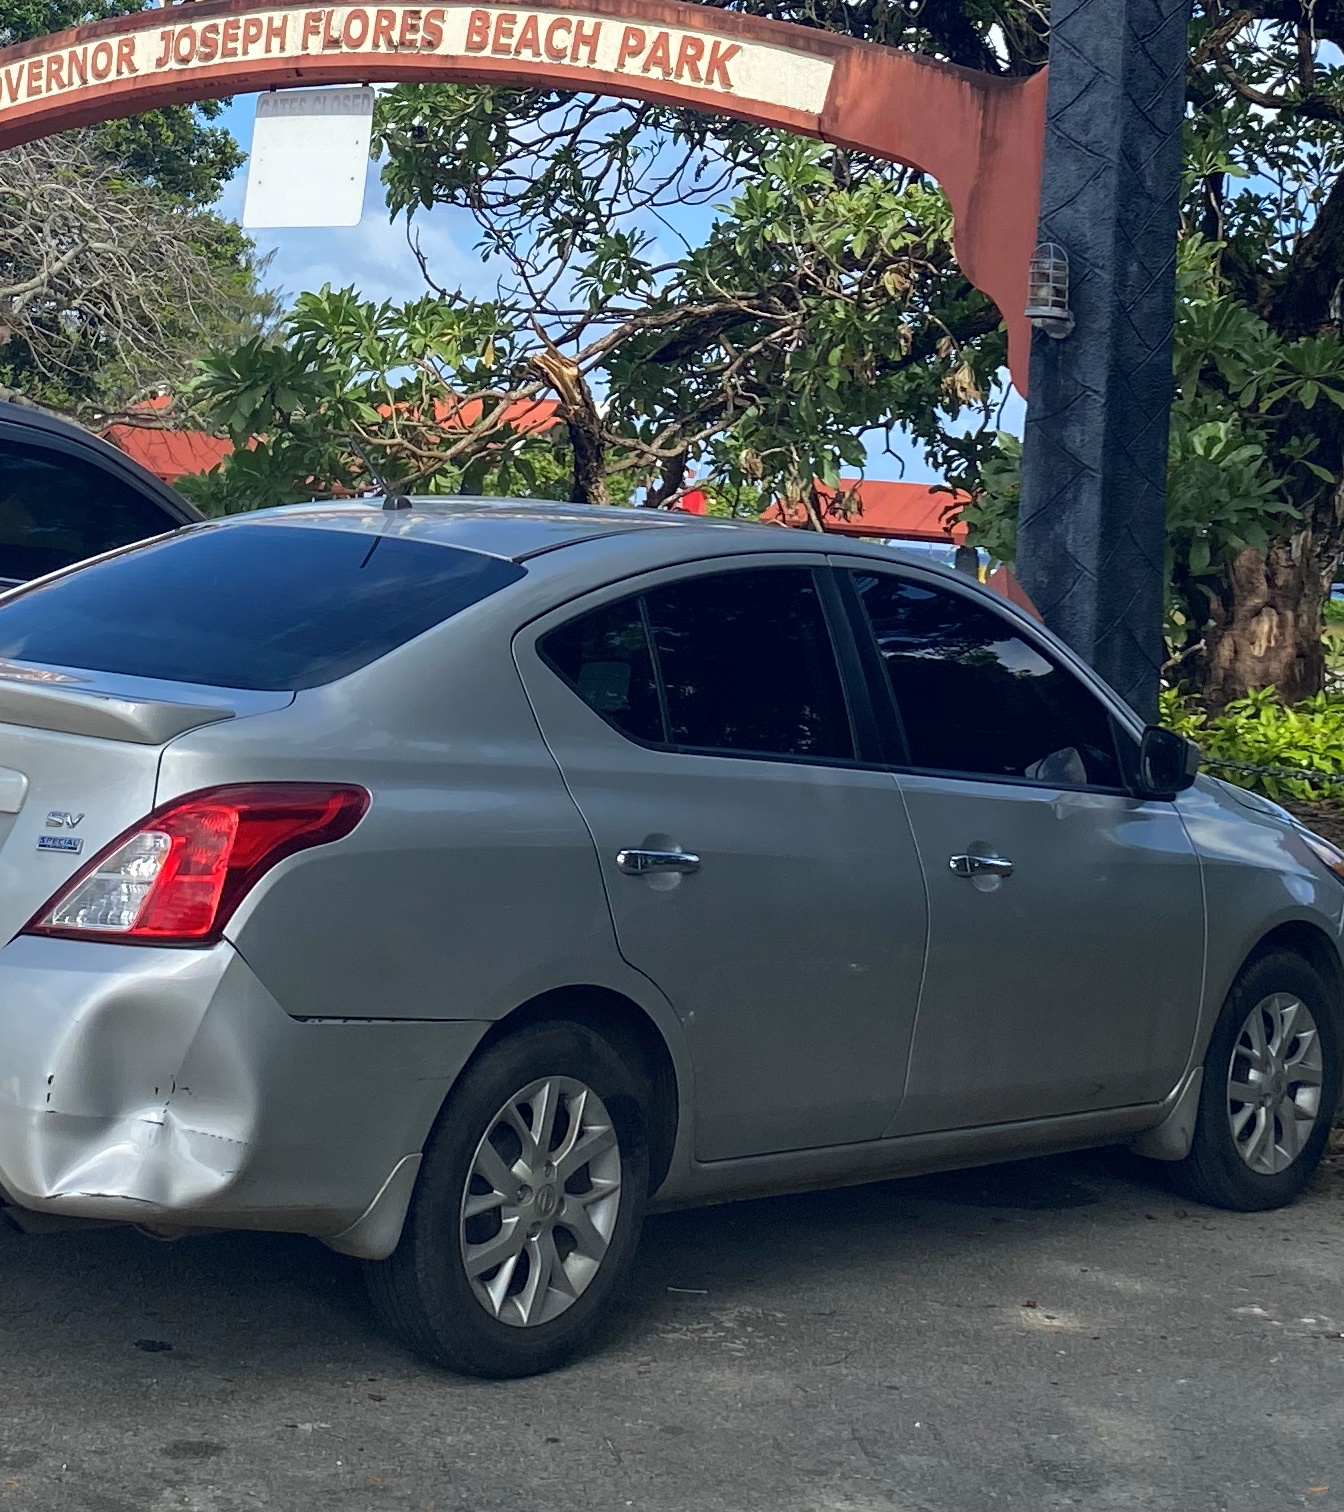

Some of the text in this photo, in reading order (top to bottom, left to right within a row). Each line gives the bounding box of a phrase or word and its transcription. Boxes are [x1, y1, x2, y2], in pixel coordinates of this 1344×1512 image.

[156, 14, 289, 69] JOSEPH
[301, 8, 447, 54] FLORES
[465, 9, 602, 65] BEACH
[617, 26, 741, 89] PARK
[46, 811, 85, 829] SV
[39, 836, 79, 847] SPECIAL
